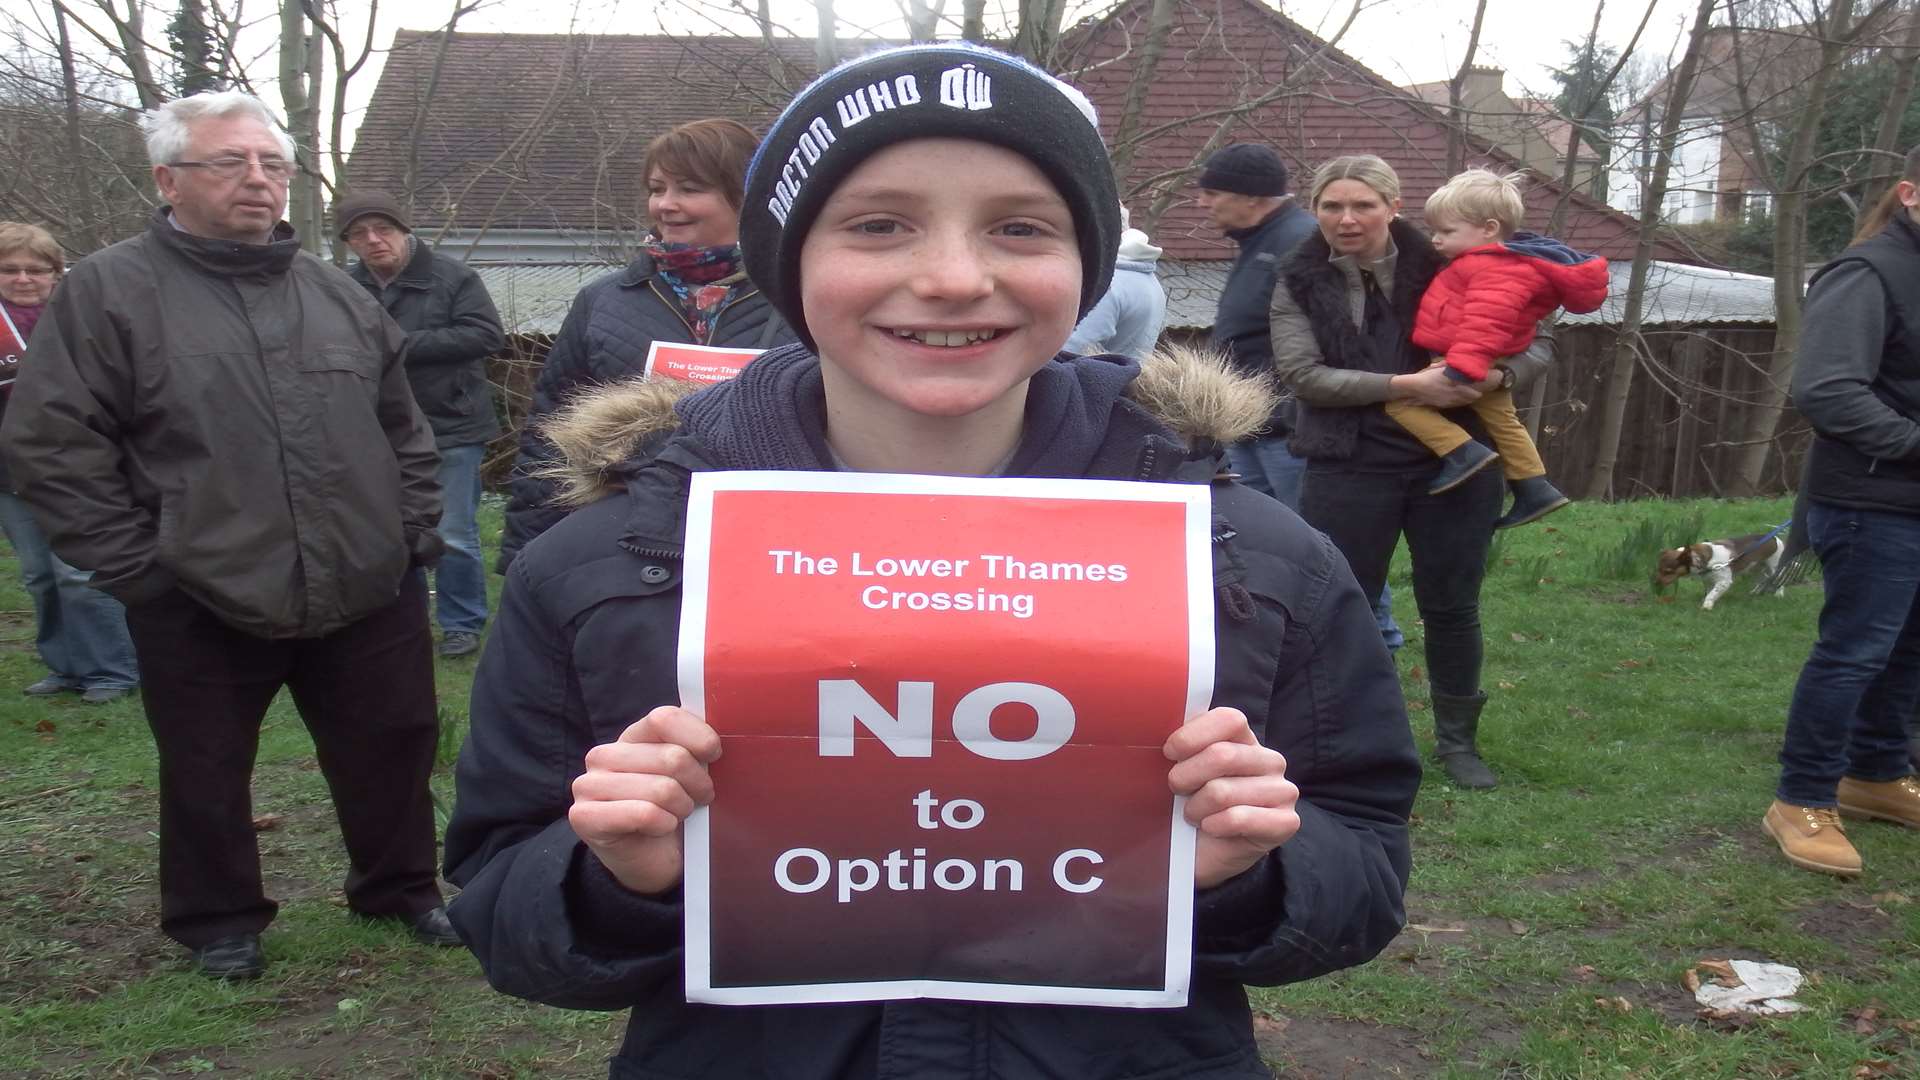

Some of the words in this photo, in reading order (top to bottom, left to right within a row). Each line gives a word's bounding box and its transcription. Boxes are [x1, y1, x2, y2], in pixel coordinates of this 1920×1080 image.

[768, 116, 837, 230] DOCTOR
[836, 74, 922, 128] WHO
[667, 361, 686, 370] The
[687, 363, 719, 373] Lower
[769, 550, 838, 576] The
[852, 553, 970, 577] Lower
[980, 554, 1128, 582] Thames
[862, 585, 1034, 618] Crossing
[818, 679, 1077, 761] NO
[912, 789, 985, 830] to
[774, 847, 1023, 903] Option
[1052, 848, 1104, 894] C
